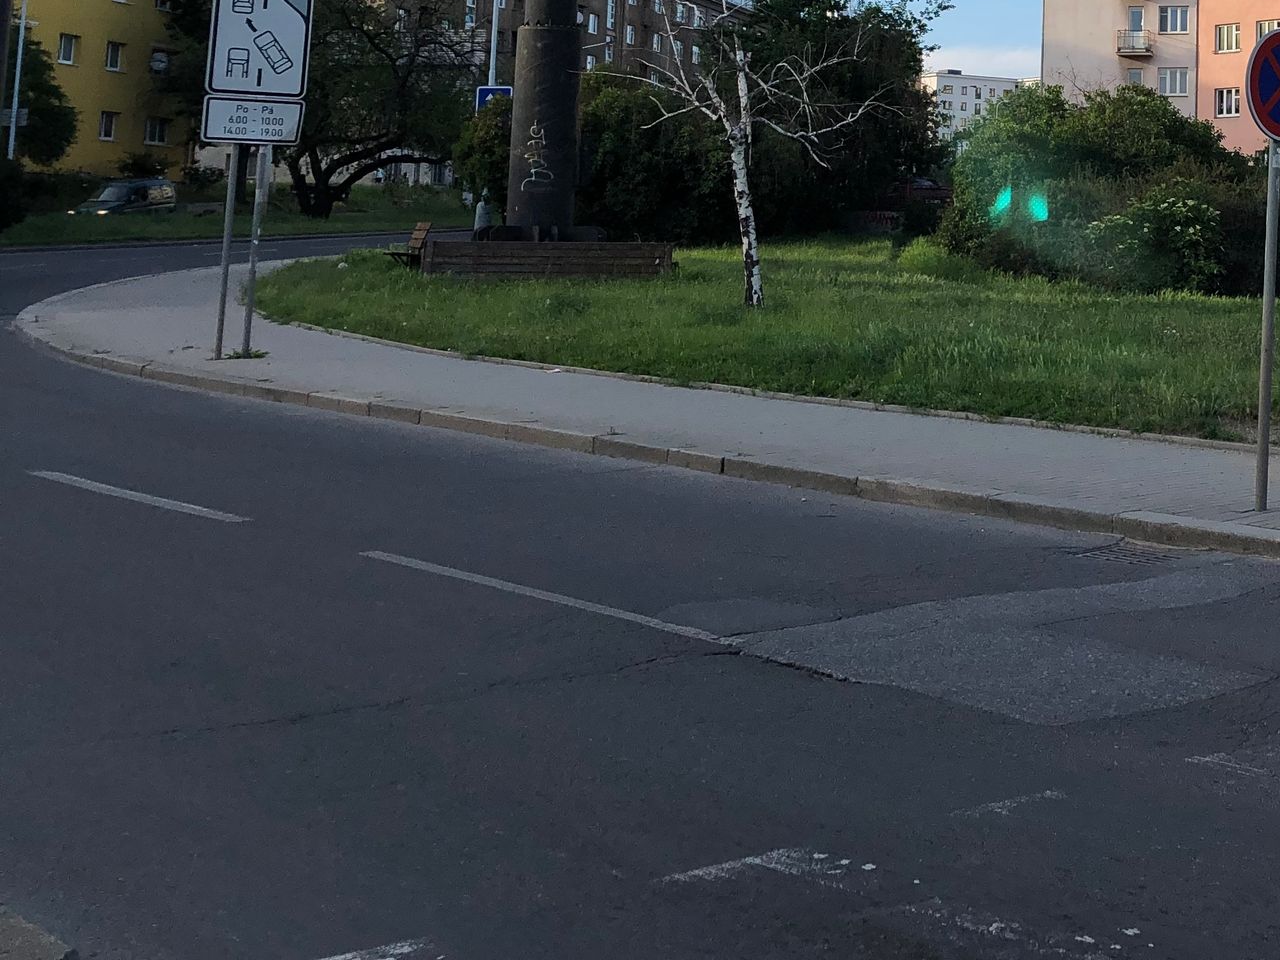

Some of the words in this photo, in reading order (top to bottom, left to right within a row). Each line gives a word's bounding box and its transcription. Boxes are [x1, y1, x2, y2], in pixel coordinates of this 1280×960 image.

[235, 104, 249, 113] Po
[261, 105, 274, 115] Pá
[260, 127, 284, 138] 19.00
